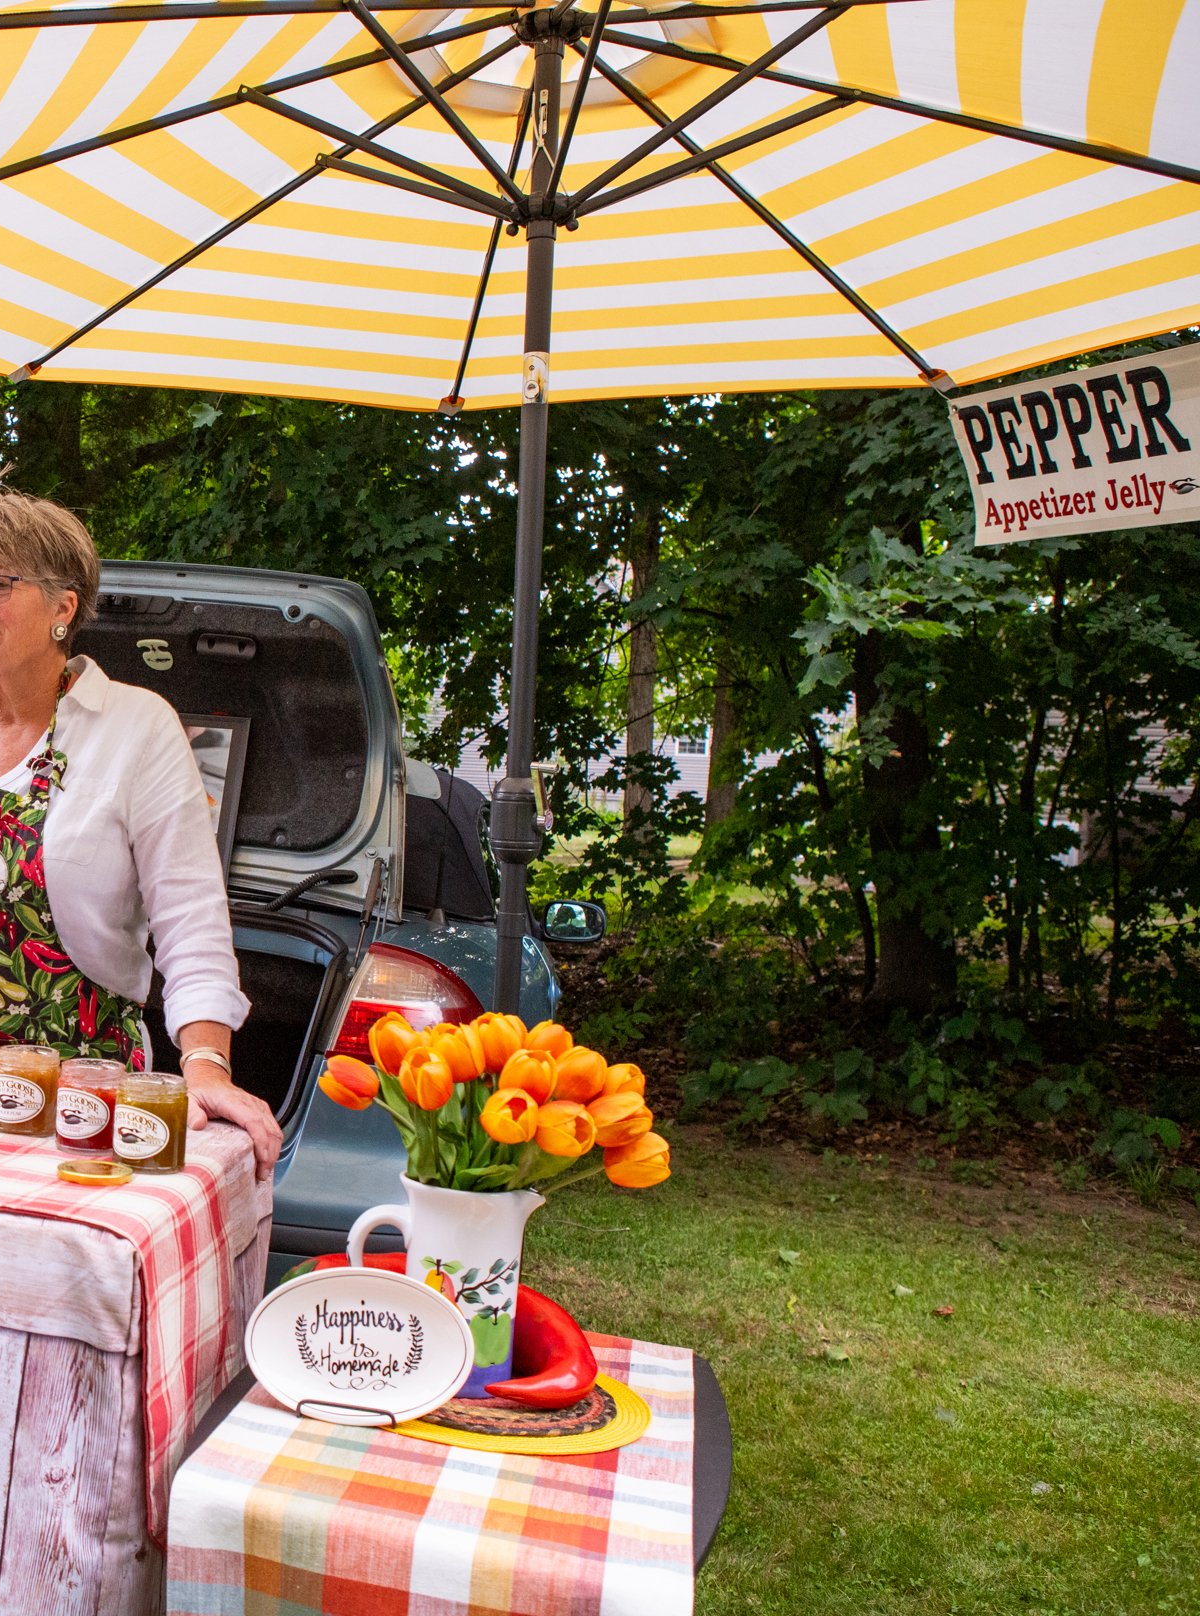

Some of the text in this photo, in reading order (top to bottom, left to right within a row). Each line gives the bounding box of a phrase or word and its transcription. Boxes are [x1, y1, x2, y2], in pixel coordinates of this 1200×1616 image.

[957, 365, 1192, 485] PEPPER
[984, 473, 1167, 534] Appetizer Jelly
[6, 1079, 36, 1099] GOOSE
[69, 1094, 99, 1115] GOOSE
[127, 1111, 159, 1134] GOOSE
[310, 1298, 405, 1345] Happiness
[320, 1341, 400, 1378] Homemade
[352, 1338, 380, 1358] is
